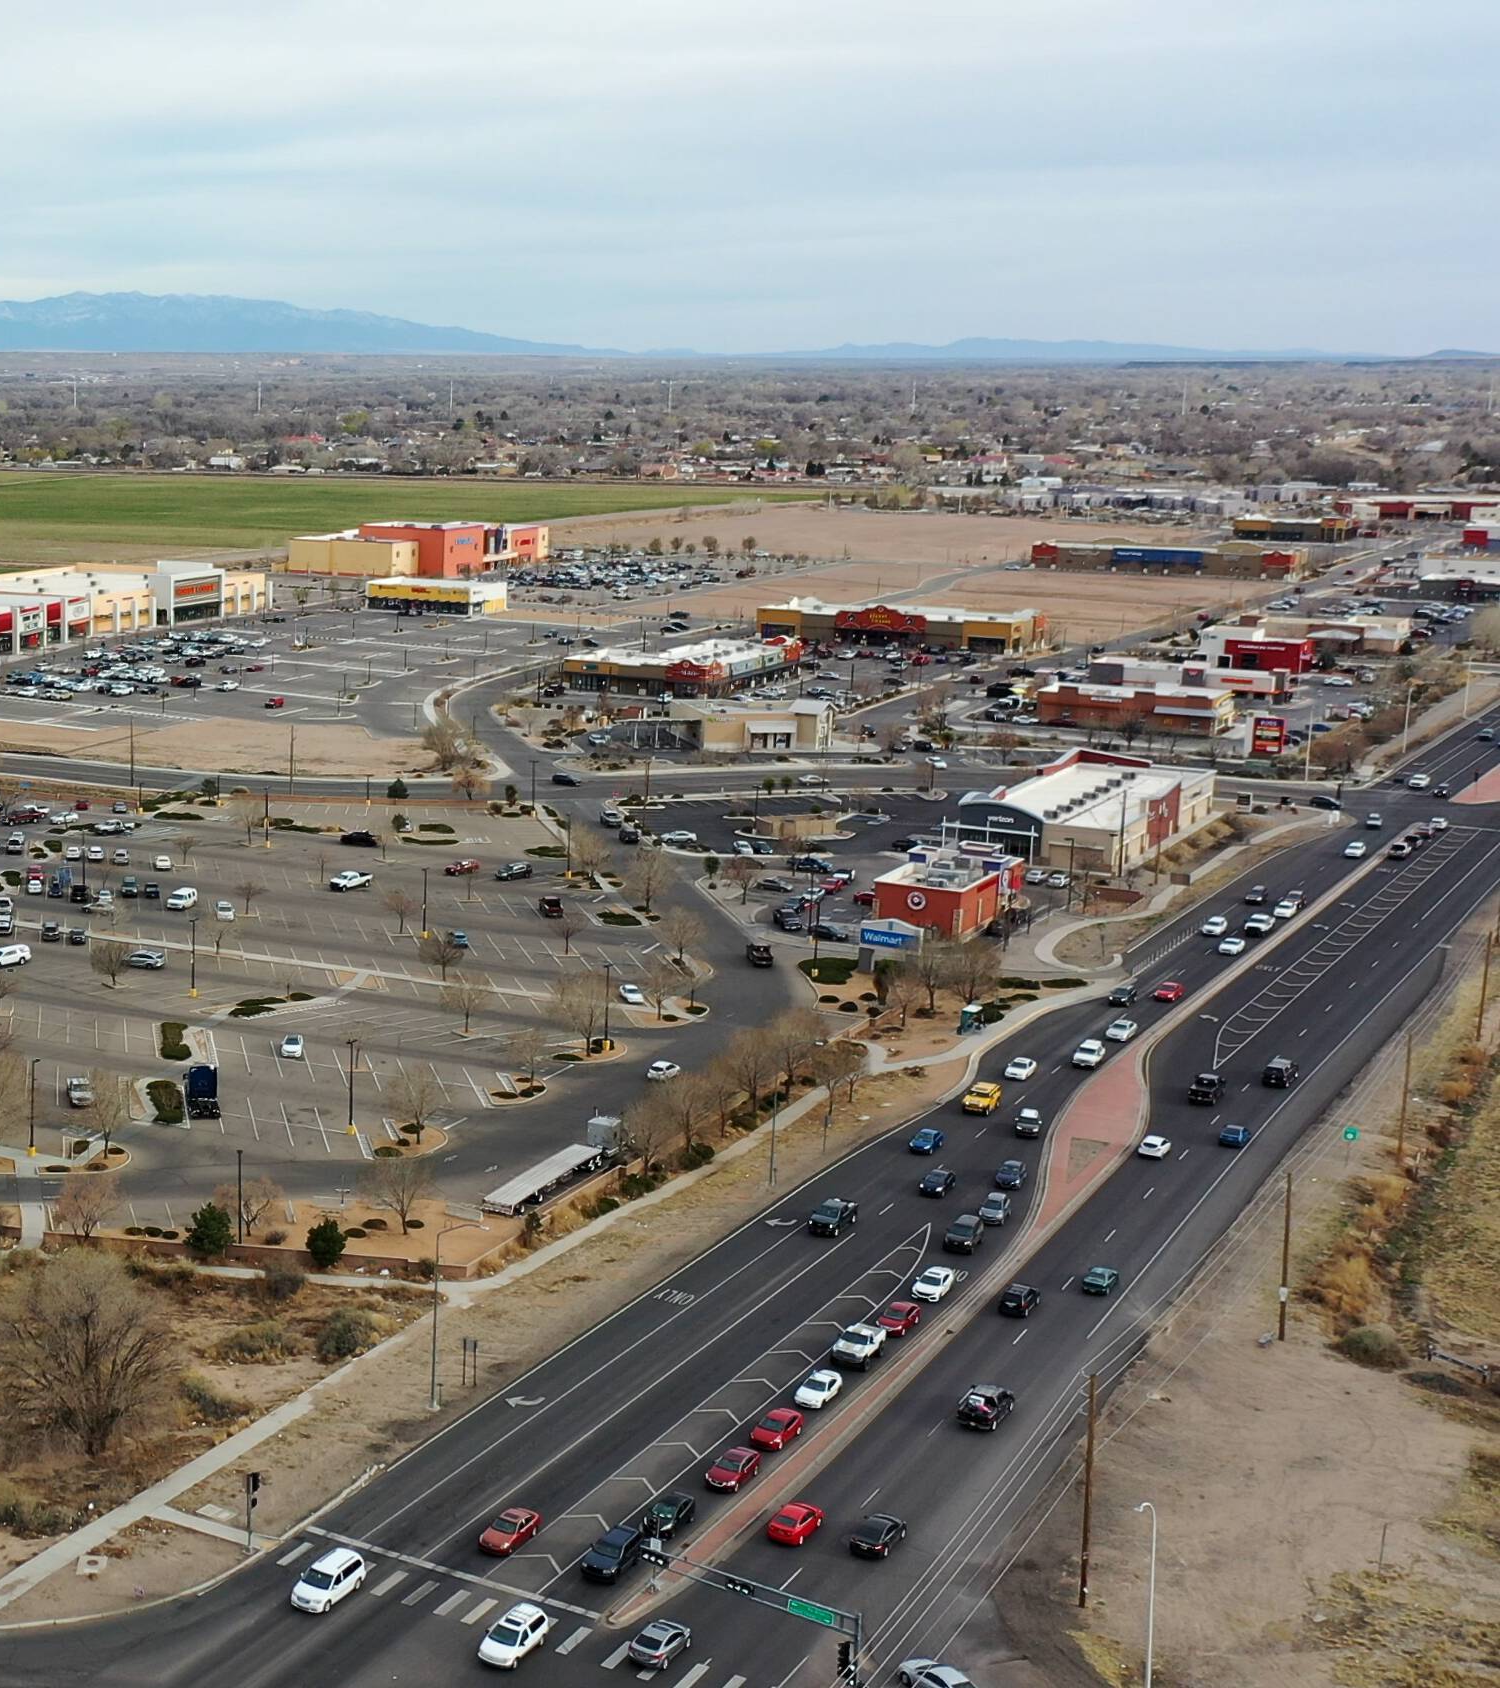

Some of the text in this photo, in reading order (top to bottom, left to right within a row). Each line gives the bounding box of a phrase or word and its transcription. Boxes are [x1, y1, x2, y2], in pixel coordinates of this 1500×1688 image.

[987, 815, 1015, 824] verizon
[863, 931, 903, 946] Walmart
[653, 1288, 695, 1305] ONLY
